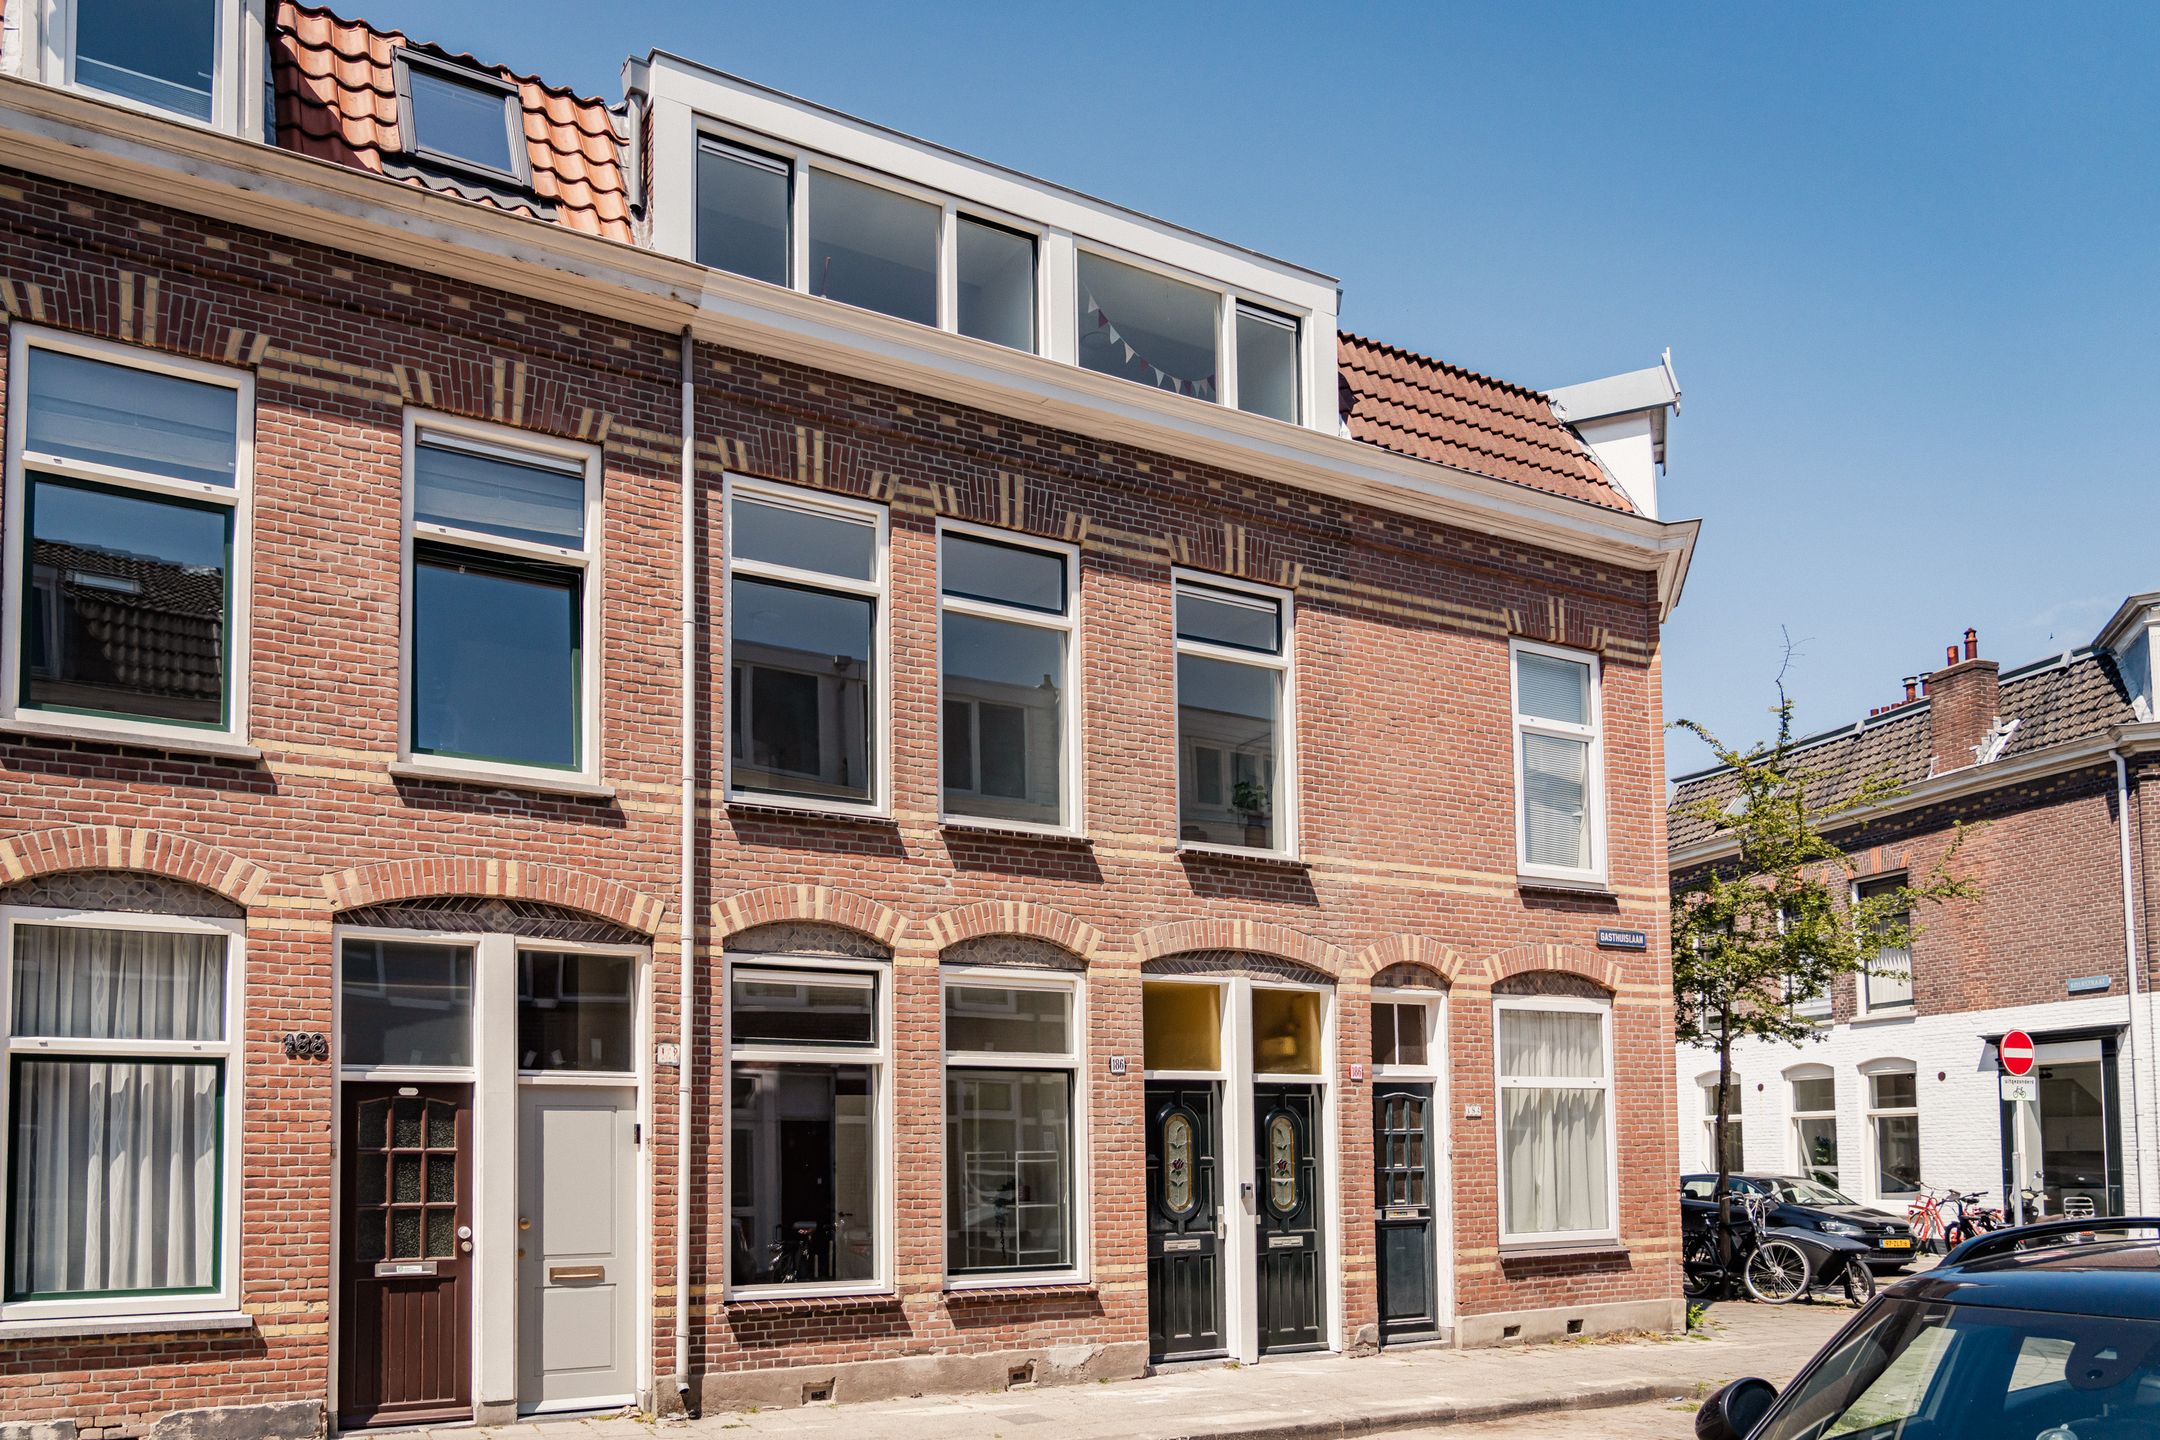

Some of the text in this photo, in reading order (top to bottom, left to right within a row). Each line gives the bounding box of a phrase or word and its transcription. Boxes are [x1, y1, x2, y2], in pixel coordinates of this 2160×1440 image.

[1600, 932, 1644, 945] GASTHUISLAAN
[282, 1032, 326, 1055] 188
[1112, 1058, 1124, 1071] 186
